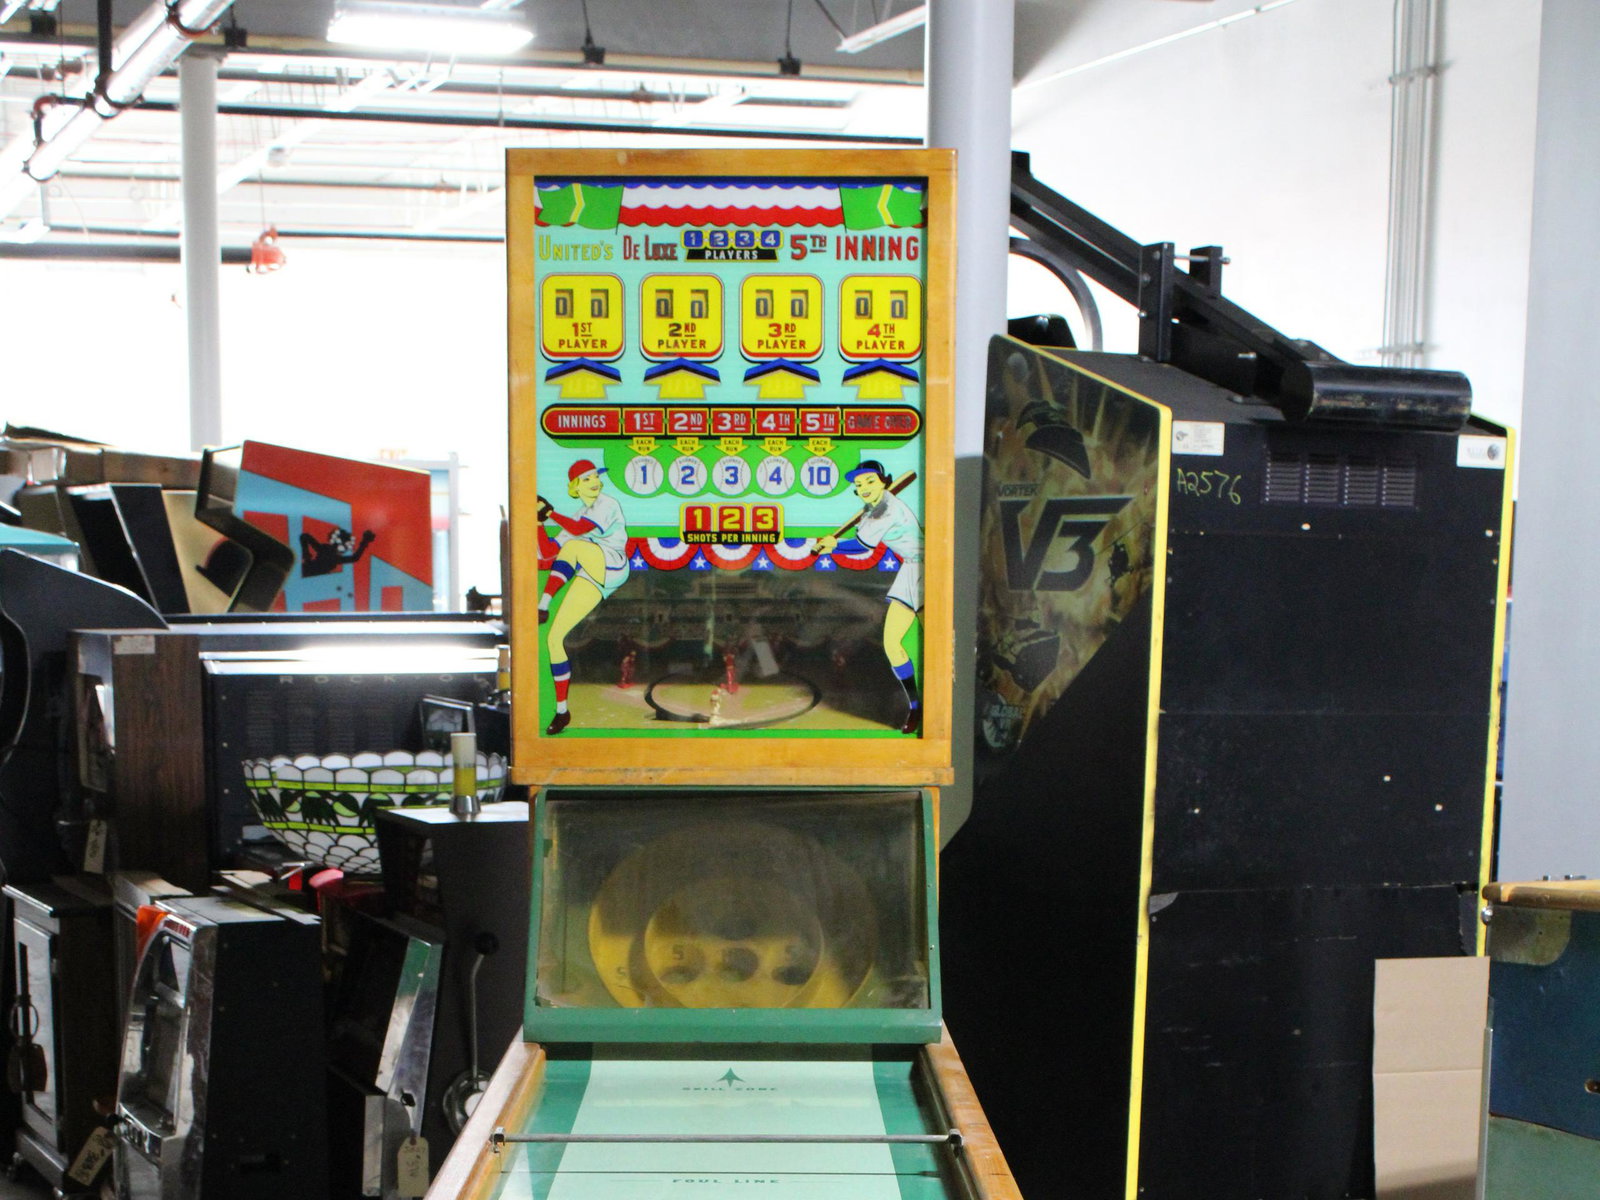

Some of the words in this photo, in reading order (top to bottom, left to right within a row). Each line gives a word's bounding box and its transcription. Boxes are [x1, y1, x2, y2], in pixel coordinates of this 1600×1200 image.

[689, 233, 696, 246] 1
[713, 233, 725, 246] 2
[739, 233, 750, 246] 3
[764, 233, 776, 246] 4
[705, 250, 758, 261] PLAYERS
[790, 234, 828, 261] 5TH
[836, 235, 920, 262] INNING
[571, 322, 593, 337] 1ST
[668, 322, 697, 337] 2ND
[768, 323, 797, 338] 3RD
[867, 323, 896, 338] 4TH
[558, 339, 608, 349] PLAYER
[657, 339, 707, 349] PLAYER
[757, 339, 806, 349] PLAYER
[856, 340, 905, 350] PLAYER
[557, 414, 607, 429] INNINGS
[633, 412, 656, 430] 1ST
[673, 412, 703, 430] 2ND
[717, 413, 747, 430] 3RD
[761, 413, 791, 430] 4TH
[806, 413, 835, 431] 5TH
[640, 465, 648, 485] 1
[680, 465, 695, 485] 2
[724, 466, 739, 485] 3
[769, 466, 782, 485] 4
[808, 466, 831, 486] 10
[1177, 467, 1242, 505] A2576
[693, 508, 703, 529] 1
[722, 508, 741, 529] 2
[755, 508, 774, 529] 3
[687, 533, 718, 542] SHOTS
[721, 533, 739, 542] PER
[742, 533, 776, 543] INNING
[999, 497, 1135, 591] V3
